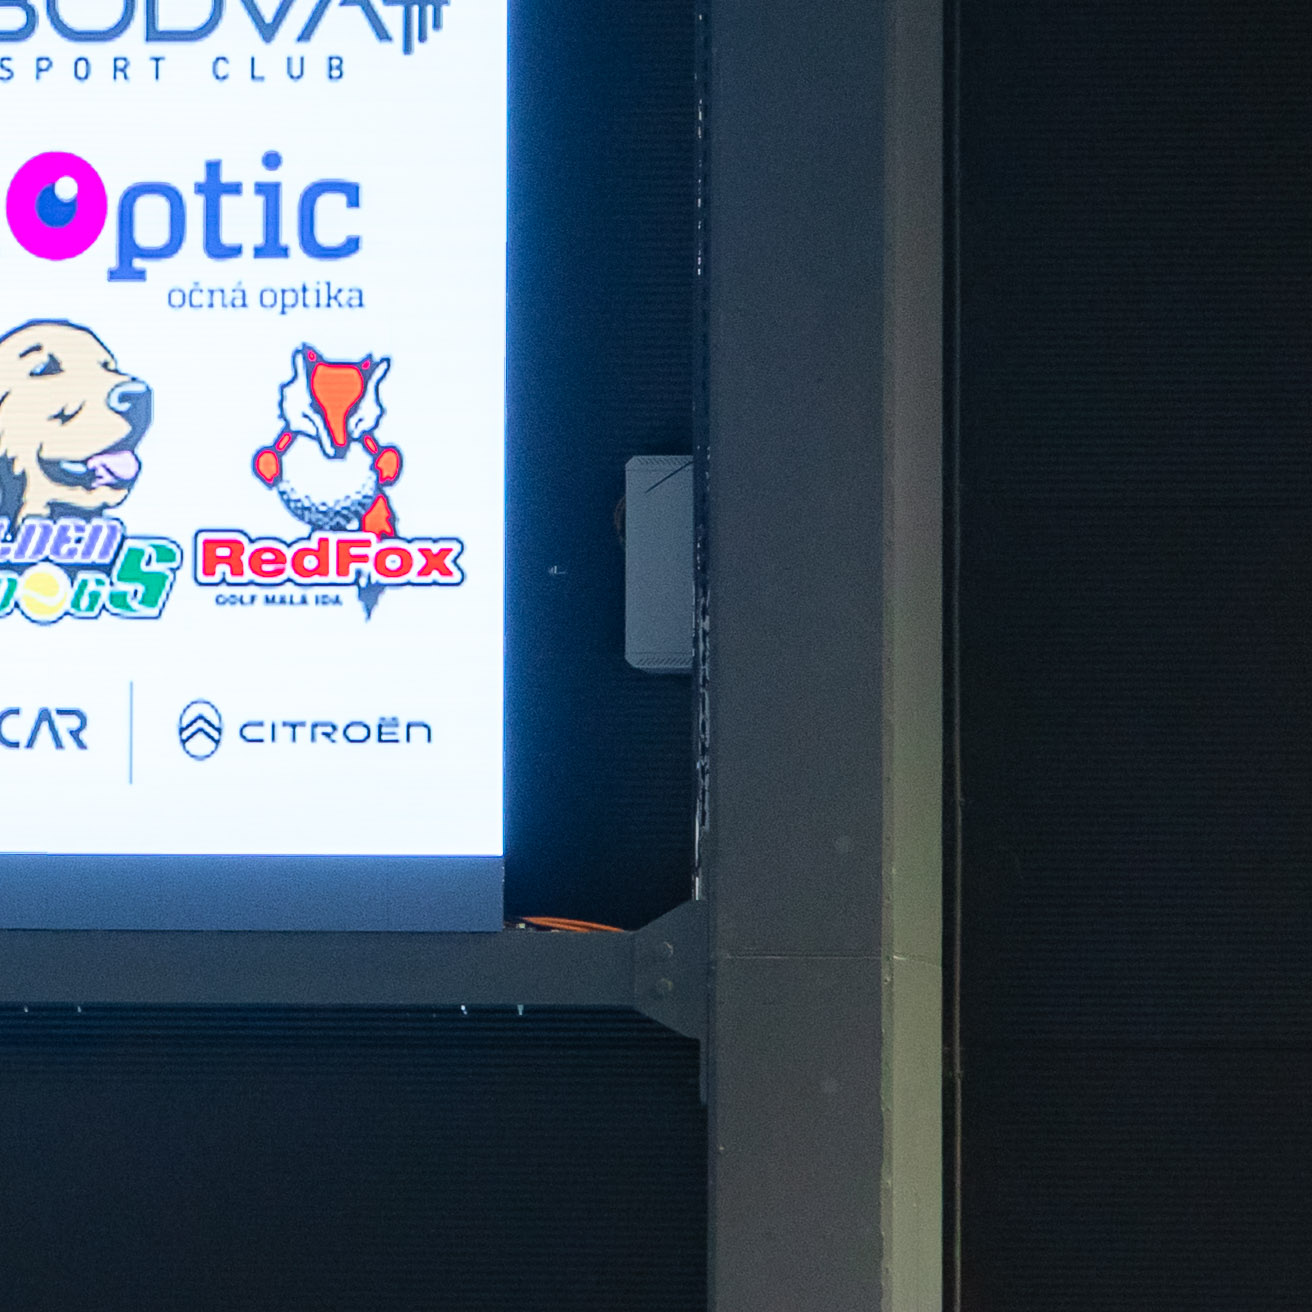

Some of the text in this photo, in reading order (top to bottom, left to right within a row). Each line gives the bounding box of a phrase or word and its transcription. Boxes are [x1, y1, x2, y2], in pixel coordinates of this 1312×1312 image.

[211, 54, 346, 83] CLUB
[167, 281, 366, 317] očná optika
[198, 533, 458, 581] RedFox
[238, 715, 433, 745] CITROËN
